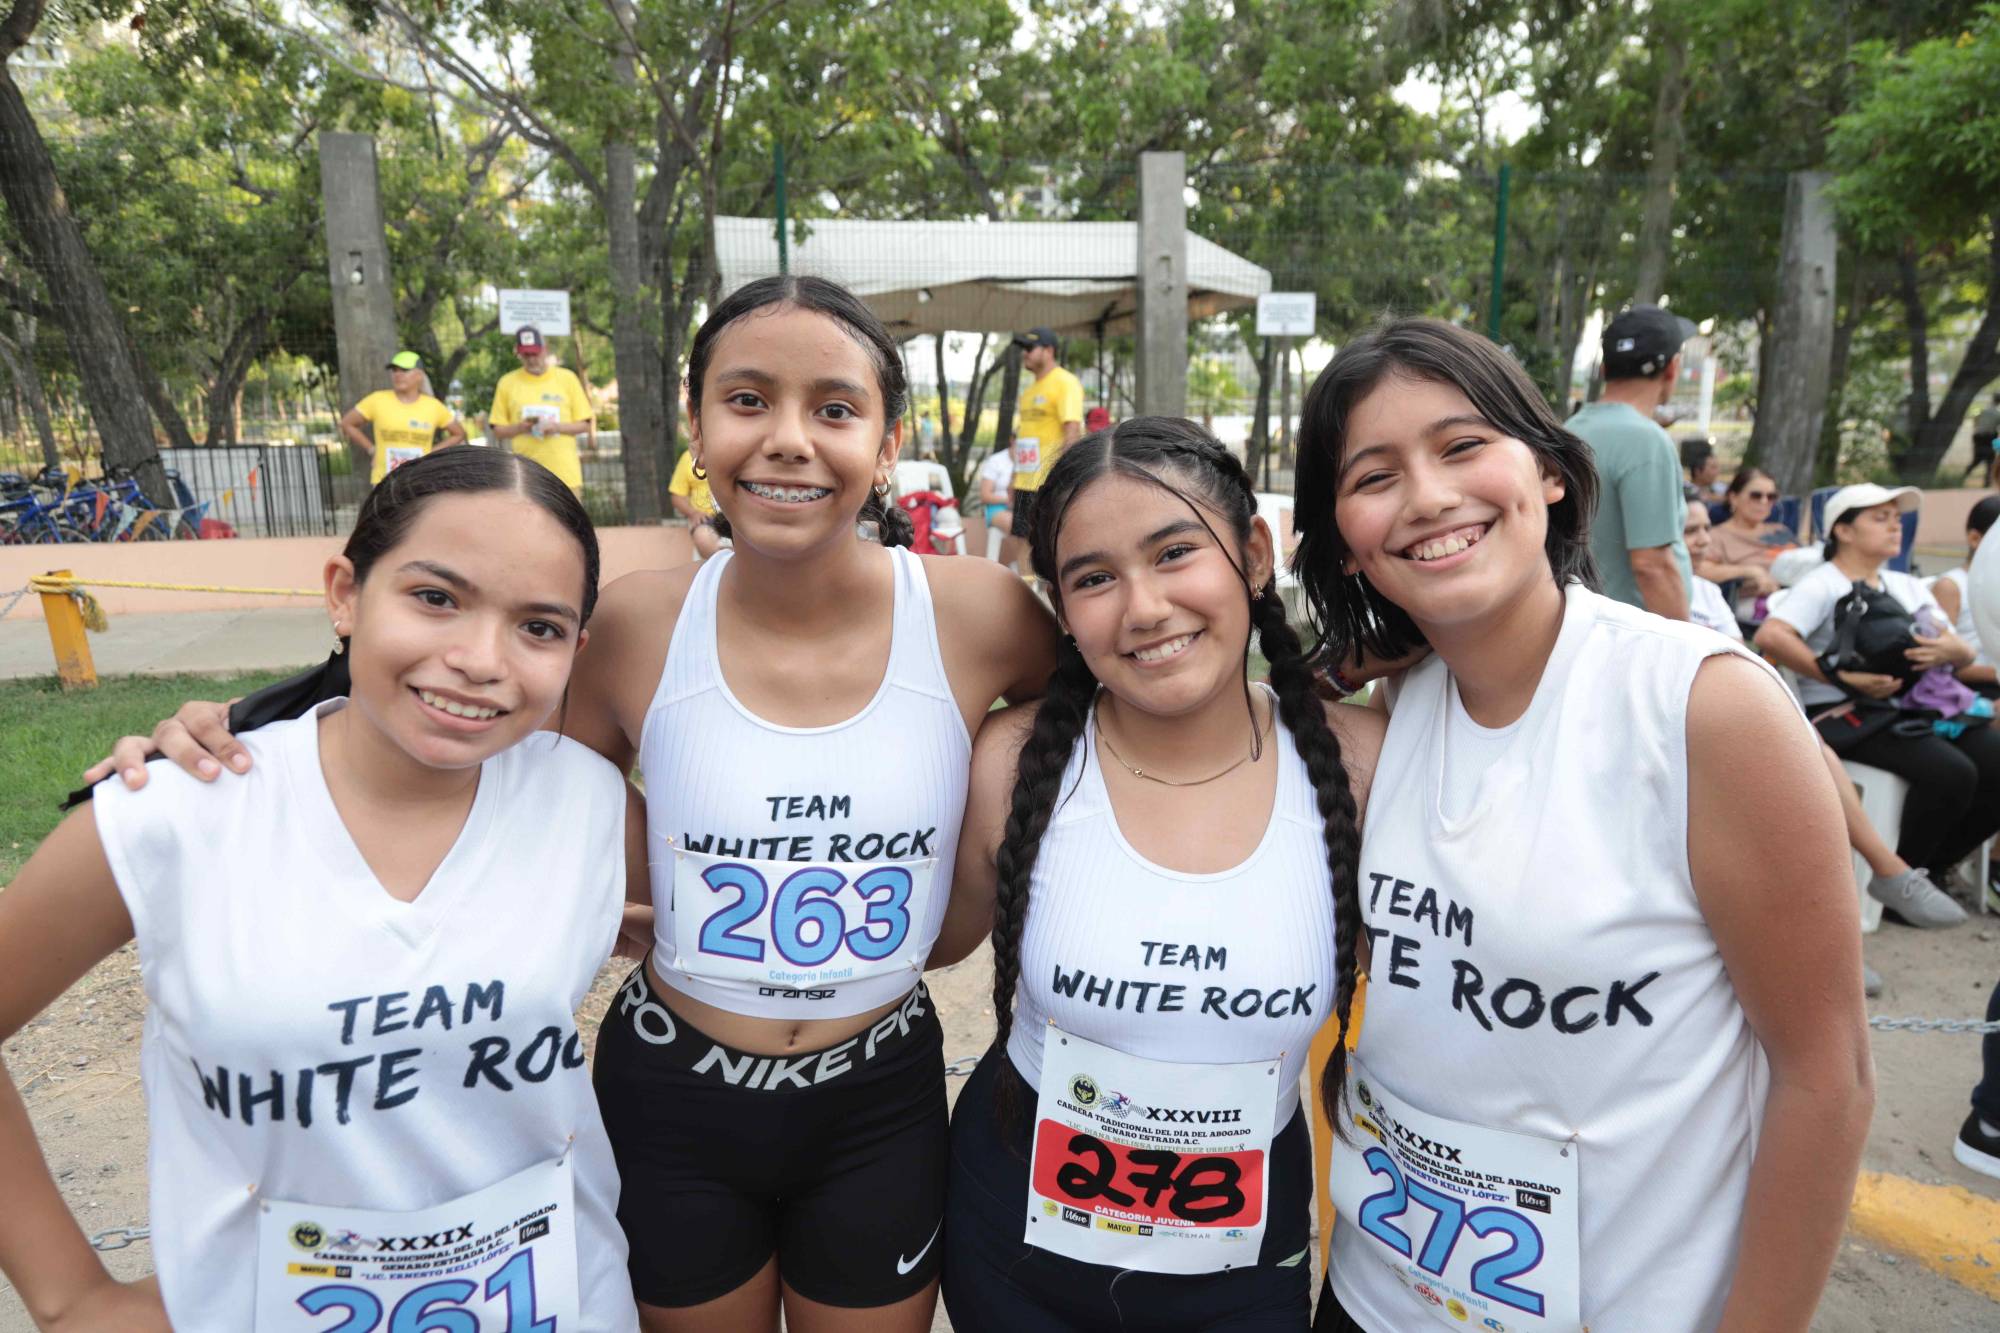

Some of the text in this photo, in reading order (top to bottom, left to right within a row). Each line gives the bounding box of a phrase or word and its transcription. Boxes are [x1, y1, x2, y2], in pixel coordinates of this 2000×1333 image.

[766, 795, 851, 821] TEAM
[684, 827, 936, 862] WHITE ROCK
[698, 863, 913, 967] 263
[1369, 872, 1473, 947] TEAM
[820, 968, 853, 979] Infantil
[1141, 941, 1227, 971] TEAM
[759, 987, 837, 1000] orange
[1052, 964, 1316, 1020] WHITE ROCK
[1451, 959, 1661, 1034] ROCK
[328, 980, 505, 1045] TEAM
[620, 963, 677, 1045] RO
[692, 1037, 859, 1090] NIKE
[192, 1048, 424, 1129] WHITE
[1057, 1099, 1093, 1118] CARRERA
[1095, 1114, 1153, 1134] TRADICIONAL
[1155, 1128, 1171, 1136] DEL
[1174, 1129, 1189, 1137] DÍA
[1209, 1128, 1251, 1137] ABOGADO
[1101, 1125, 1137, 1139] GENARO
[1139, 1133, 1181, 1144] ESTRADA
[1146, 1106, 1241, 1123] XXXVIII
[1393, 1119, 1462, 1164] XXXIX
[1056, 1134, 1245, 1222] 278
[1393, 1136, 1442, 1169] TRADICIONAL
[1444, 1164, 1462, 1175] DEL
[1465, 1170, 1482, 1180] DÍA
[1485, 1175, 1505, 1185] DEL
[1508, 1178, 1561, 1195] ABOGADO
[1398, 1148, 1497, 1191] GENARO ESTRADA A.C.
[1440, 1181, 1469, 1195] KELLY
[371, 1250, 451, 1263] TRADICIONAL
[453, 1243, 473, 1254] DEL
[475, 1235, 493, 1246] DÍA
[494, 1225, 511, 1238] DEL
[513, 1203, 557, 1229] ABOGADO
[377, 1222, 474, 1251] XXXIX
[1107, 1222, 1132, 1232] MATCO
[1359, 1147, 1545, 1318] 272
[381, 1262, 430, 1271] GENARO
[433, 1248, 484, 1267] ESTRADA
[445, 1260, 479, 1274] KELLY
